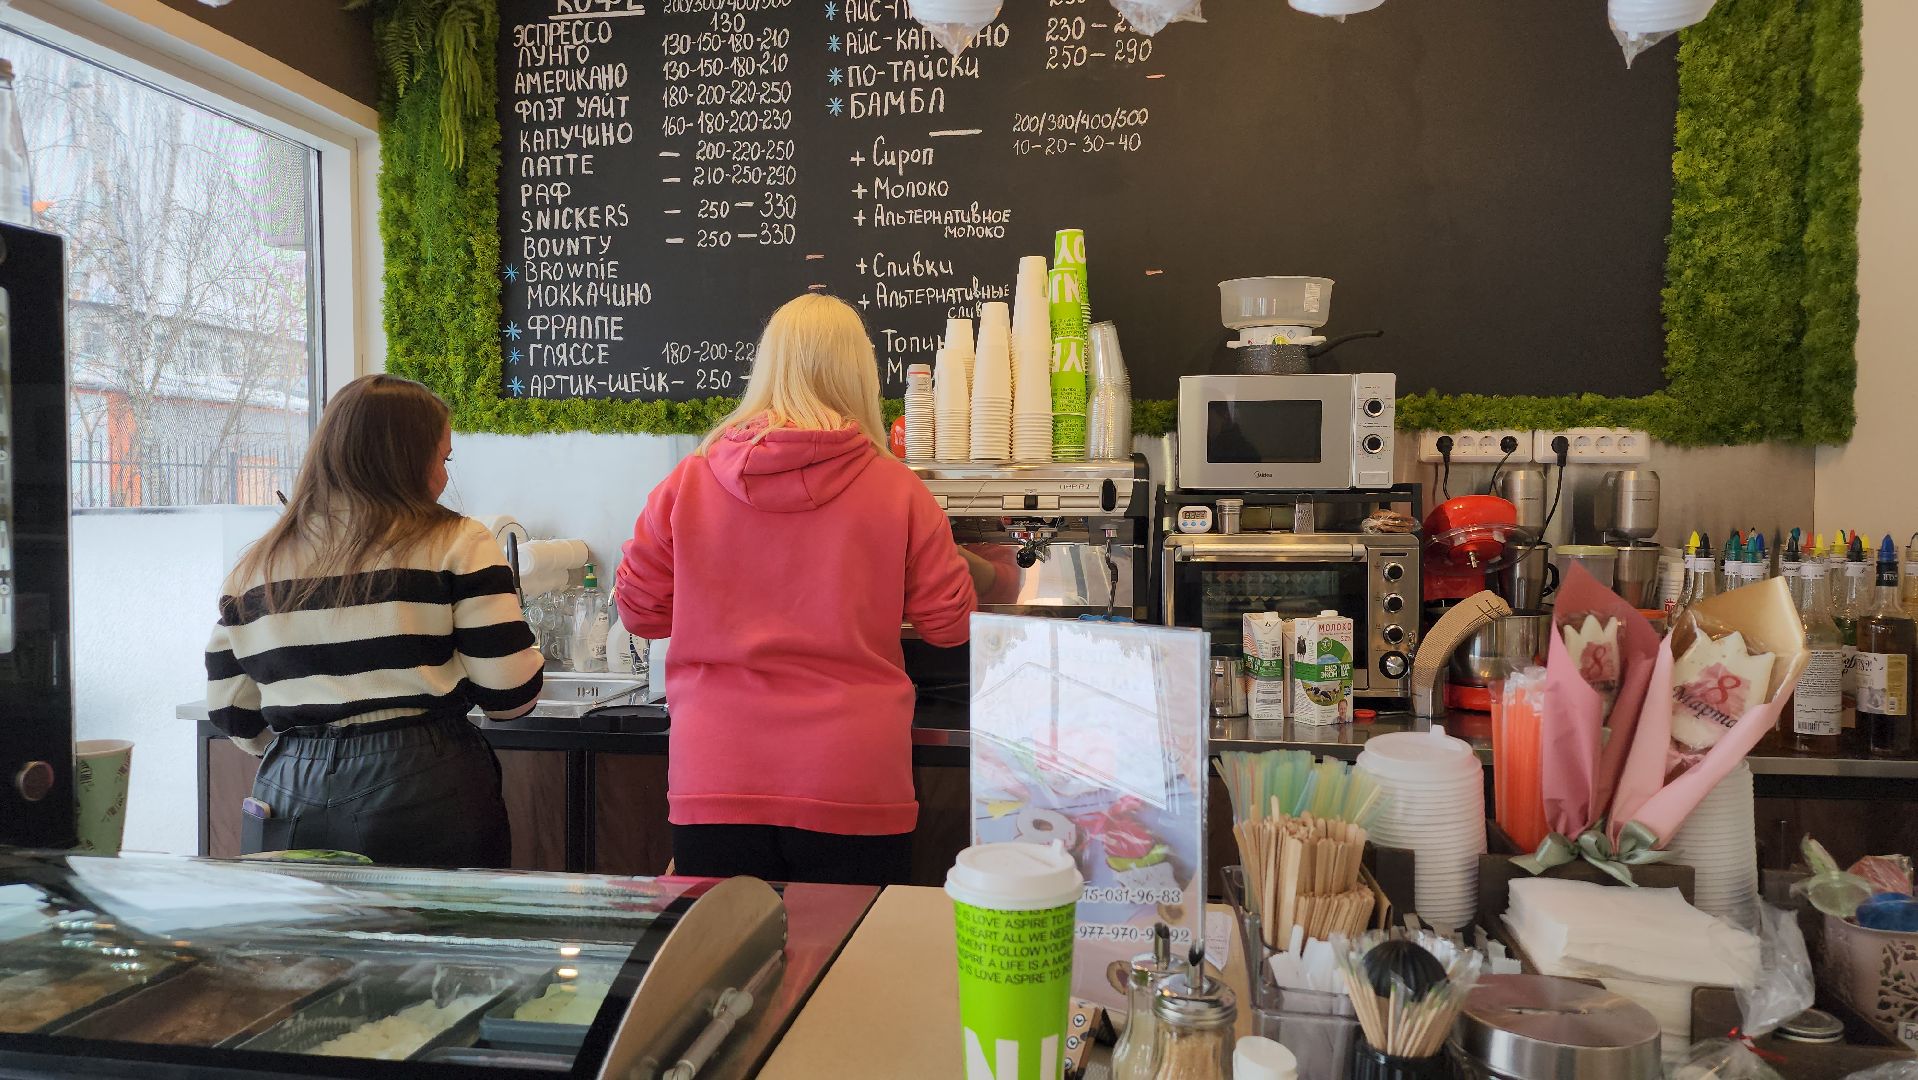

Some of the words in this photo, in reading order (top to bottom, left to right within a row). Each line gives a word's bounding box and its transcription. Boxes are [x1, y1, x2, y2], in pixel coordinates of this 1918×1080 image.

[514, 20, 612, 47] ЭСПРЕССО
[710, 12, 745, 32] 130
[1046, 17, 1085, 42] 230
[847, 23, 1009, 57] АЙС-КАПНО
[519, 44, 589, 67] ЛУНГО
[1046, 45, 1087, 69] 250
[1115, 39, 1152, 63] 290
[515, 62, 627, 94] АМЕРИКАНО
[847, 51, 979, 87] ПО-ТАЙСКИ
[515, 97, 565, 123] ФЛЭТ
[577, 93, 629, 118] УАЙТ
[851, 87, 944, 119] БАМБЛ
[1013, 108, 1148, 136] 200/300/400/500
[521, 122, 632, 152] КАПУЧИНО
[522, 154, 593, 177] ЛАТТЕ
[873, 135, 934, 176] Сироп
[521, 182, 571, 207] РАФ
[875, 177, 949, 199] Молоко
[521, 204, 628, 233] SNICKERS
[524, 236, 611, 260] BOUNTY
[873, 251, 953, 277] Сливки
[528, 282, 651, 309] МОККАЧИНО
[947, 300, 984, 320] слив
[528, 315, 623, 340] ФРАППЕ
[529, 342, 609, 367] ГЛЯССЕ
[697, 369, 731, 389] 250
[1318, 622, 1352, 632] МОЛОКО
[972, 913, 1001, 928] LOVE
[1005, 918, 1048, 929] ASPIRE
[1003, 932, 1025, 943] ALL
[1029, 931, 1048, 942] WE
[991, 944, 1040, 957] FOLLOW
[975, 969, 1002, 984] LOVE
[1005, 974, 1045, 985] ASPIRE
[1000, 960, 1025, 971] LIFE
[1029, 960, 1039, 971] IS
